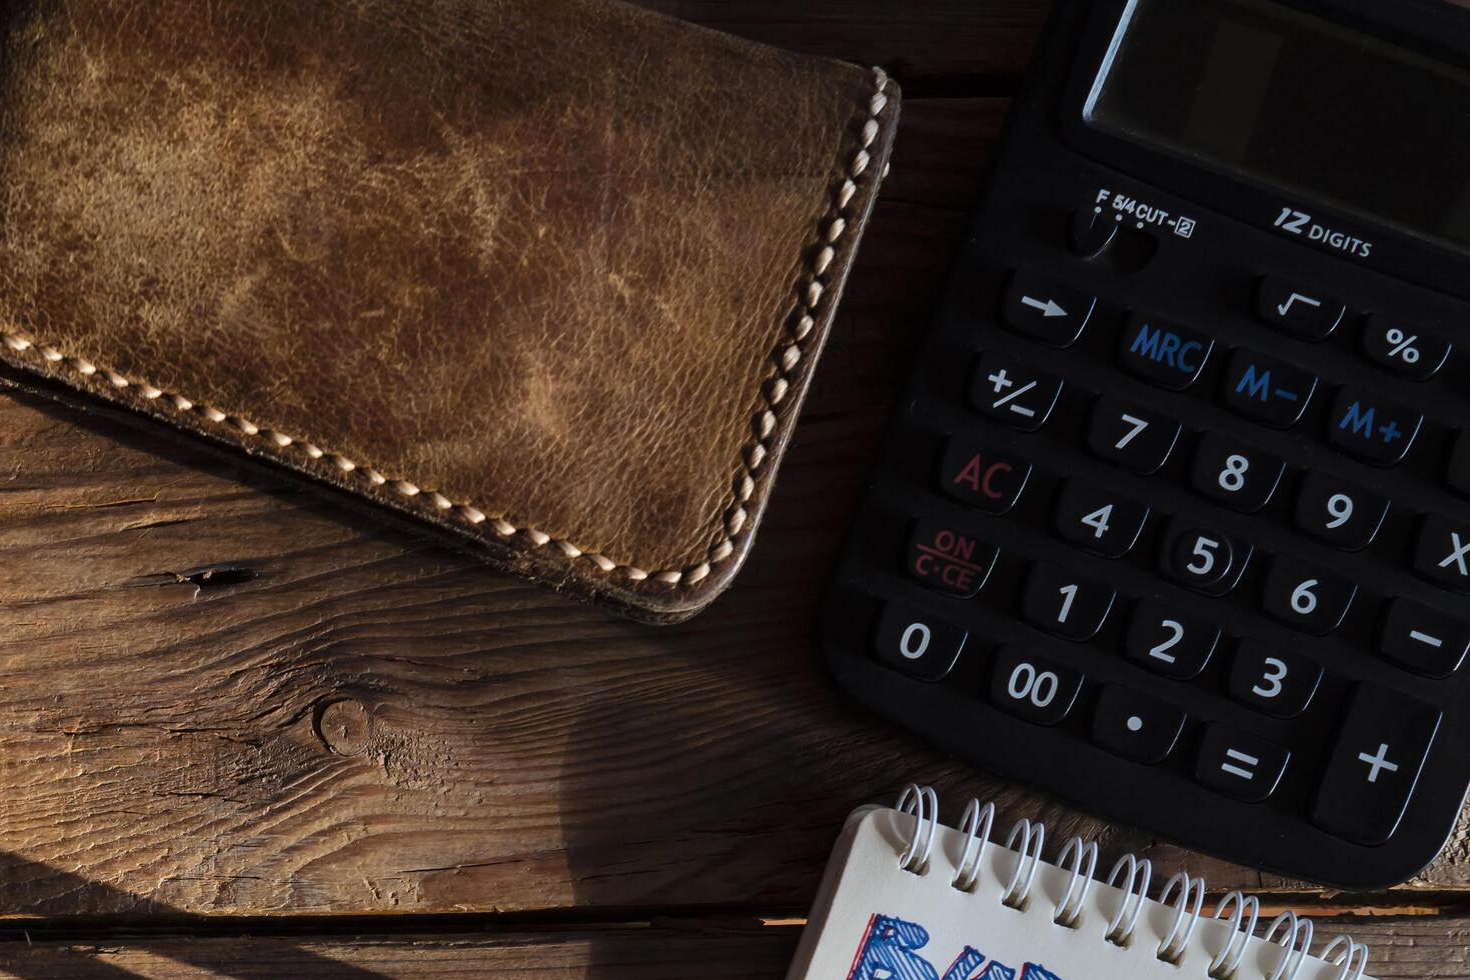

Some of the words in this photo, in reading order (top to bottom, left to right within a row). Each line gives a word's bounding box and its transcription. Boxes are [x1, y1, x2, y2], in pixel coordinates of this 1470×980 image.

[1273, 206, 1311, 235] 12
[1308, 224, 1373, 258] DIGITS
[1130, 324, 1204, 375] MRC
[1114, 413, 1149, 449] 7
[1338, 400, 1402, 443] M+
[953, 453, 1013, 499] AC
[1218, 454, 1249, 492] 8
[1081, 504, 1114, 538] 4
[1325, 493, 1354, 529] 9
[933, 529, 977, 562] ON
[1186, 536, 1220, 575] 5
[1057, 584, 1079, 623] 1
[1290, 579, 1318, 614] 6
[899, 622, 931, 660] 0
[1148, 619, 1184, 664] 2
[1007, 662, 1060, 708] 00
[1252, 657, 1288, 698] 3
